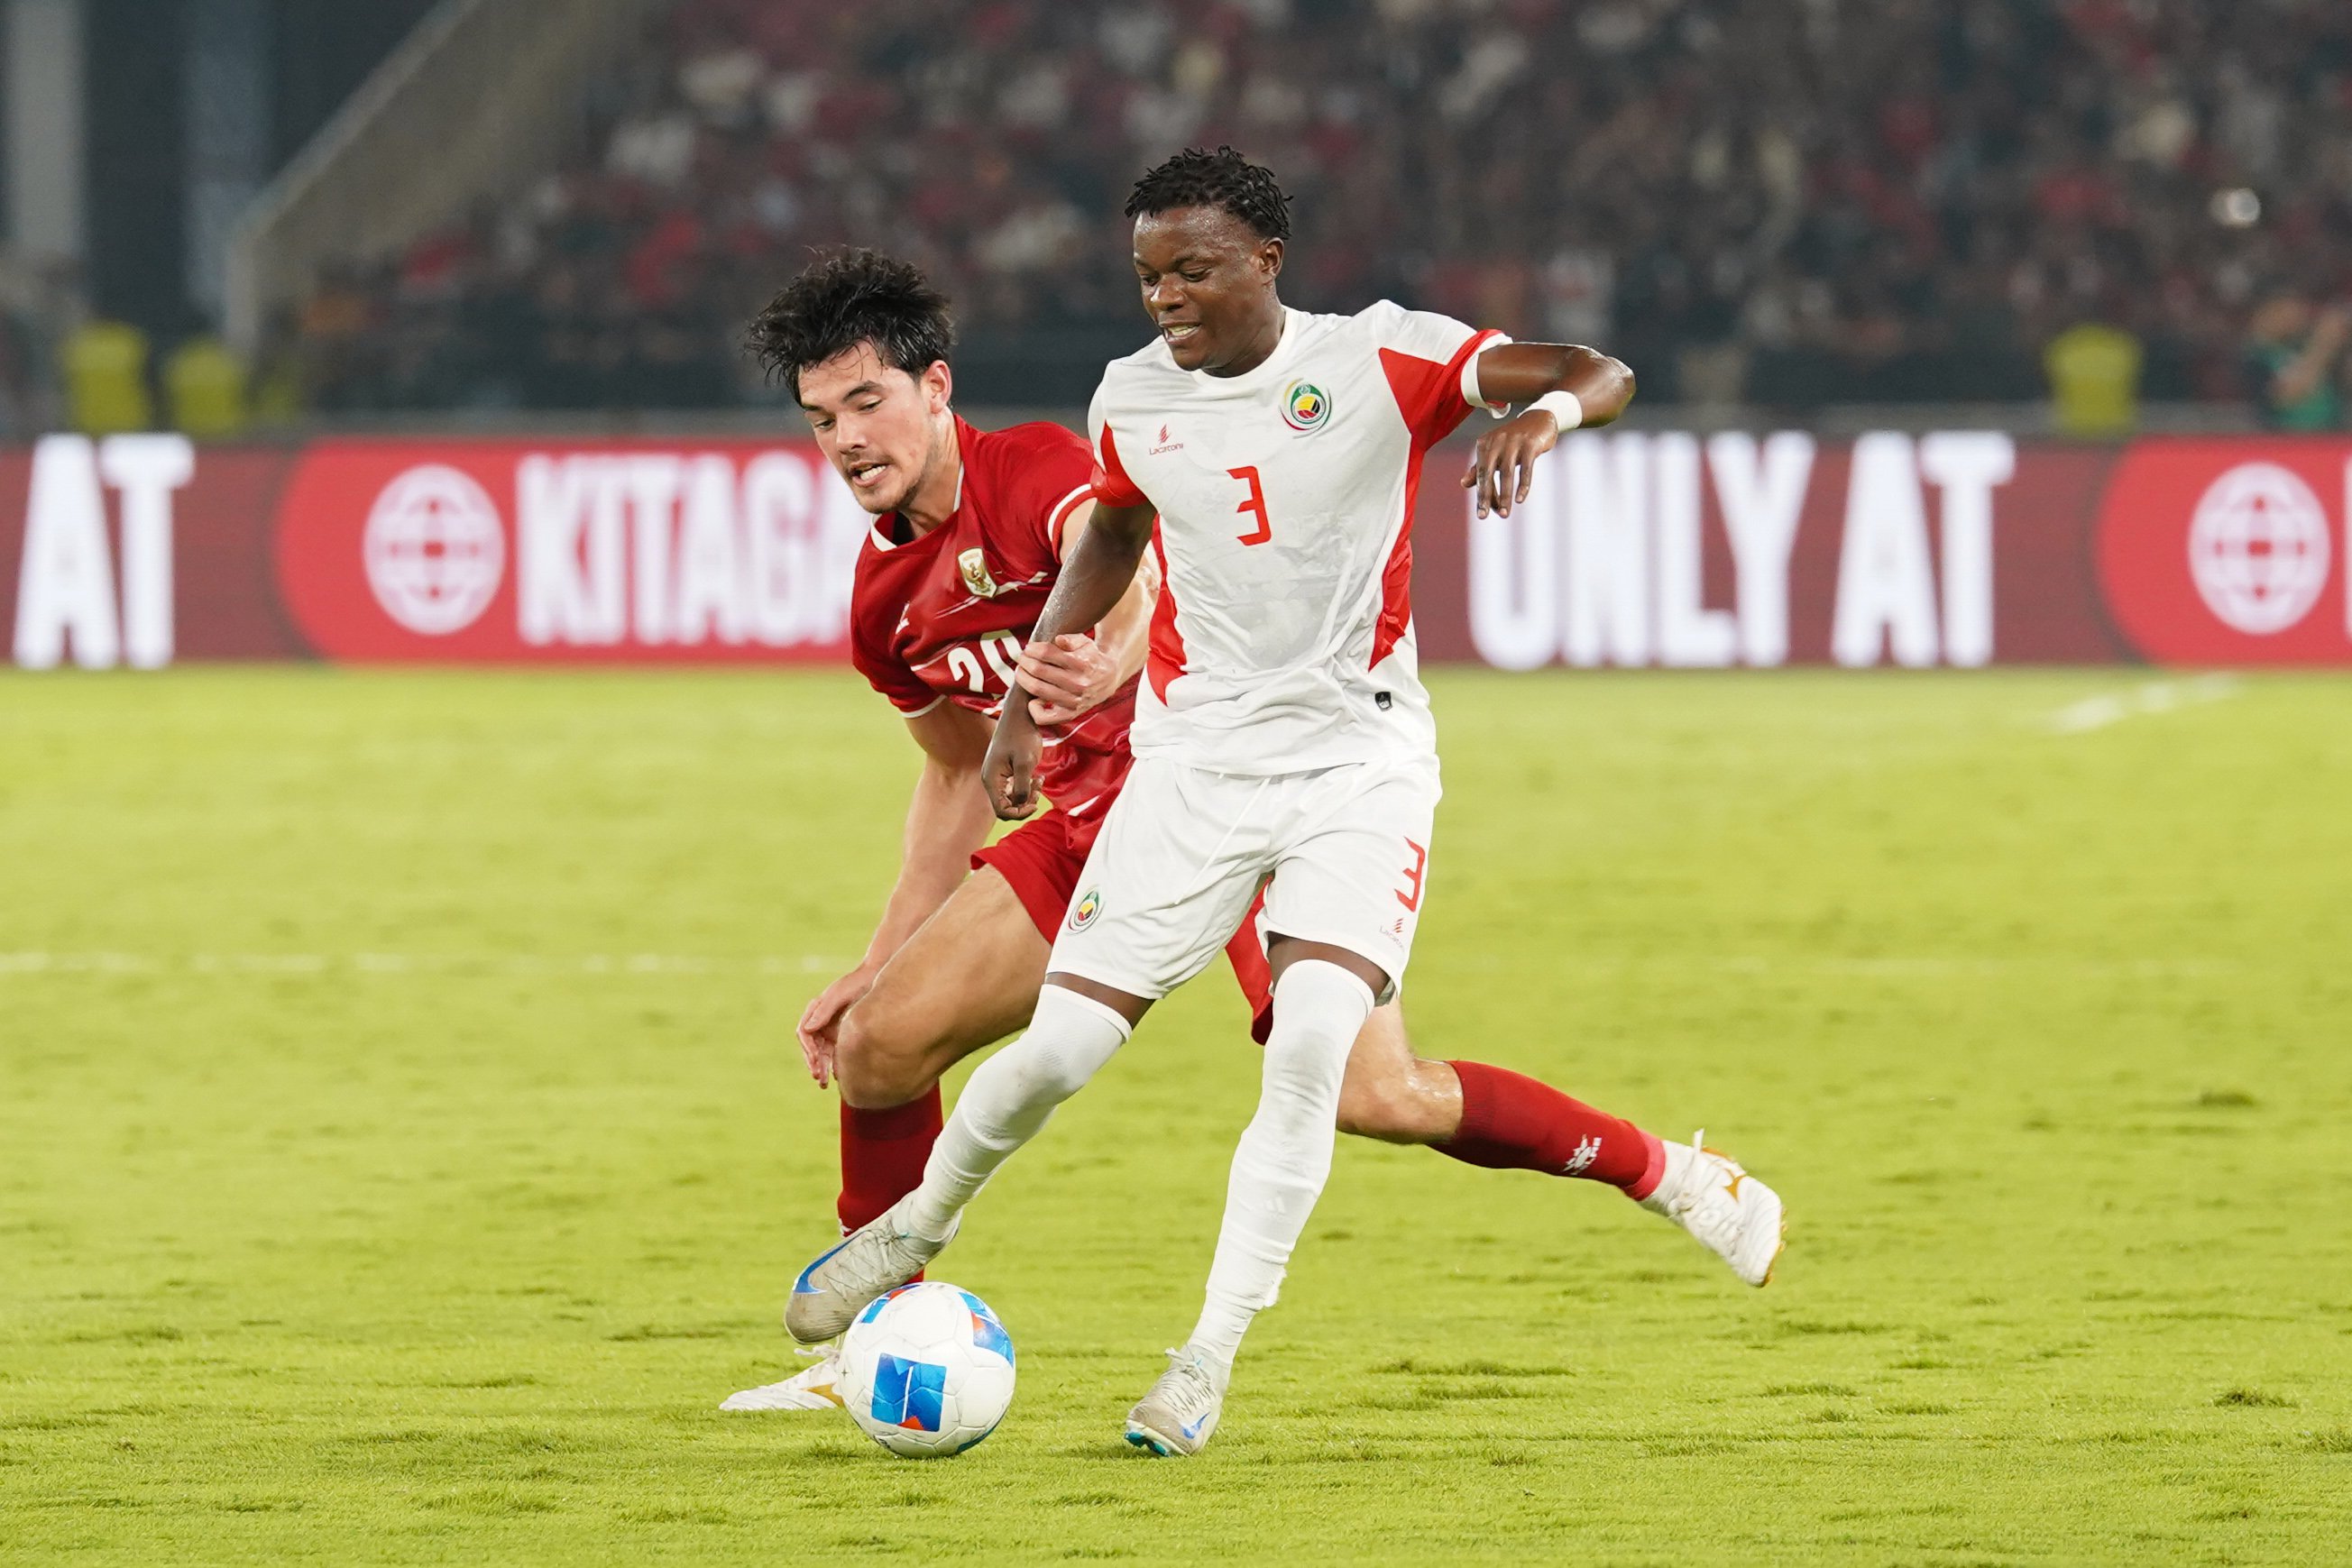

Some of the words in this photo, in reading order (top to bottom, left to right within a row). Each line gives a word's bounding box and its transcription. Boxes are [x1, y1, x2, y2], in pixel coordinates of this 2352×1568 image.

[14, 434, 195, 670] AT
[1226, 465, 1272, 546] 3
[1831, 431, 2016, 669] AT
[1393, 835, 1426, 912] 3
